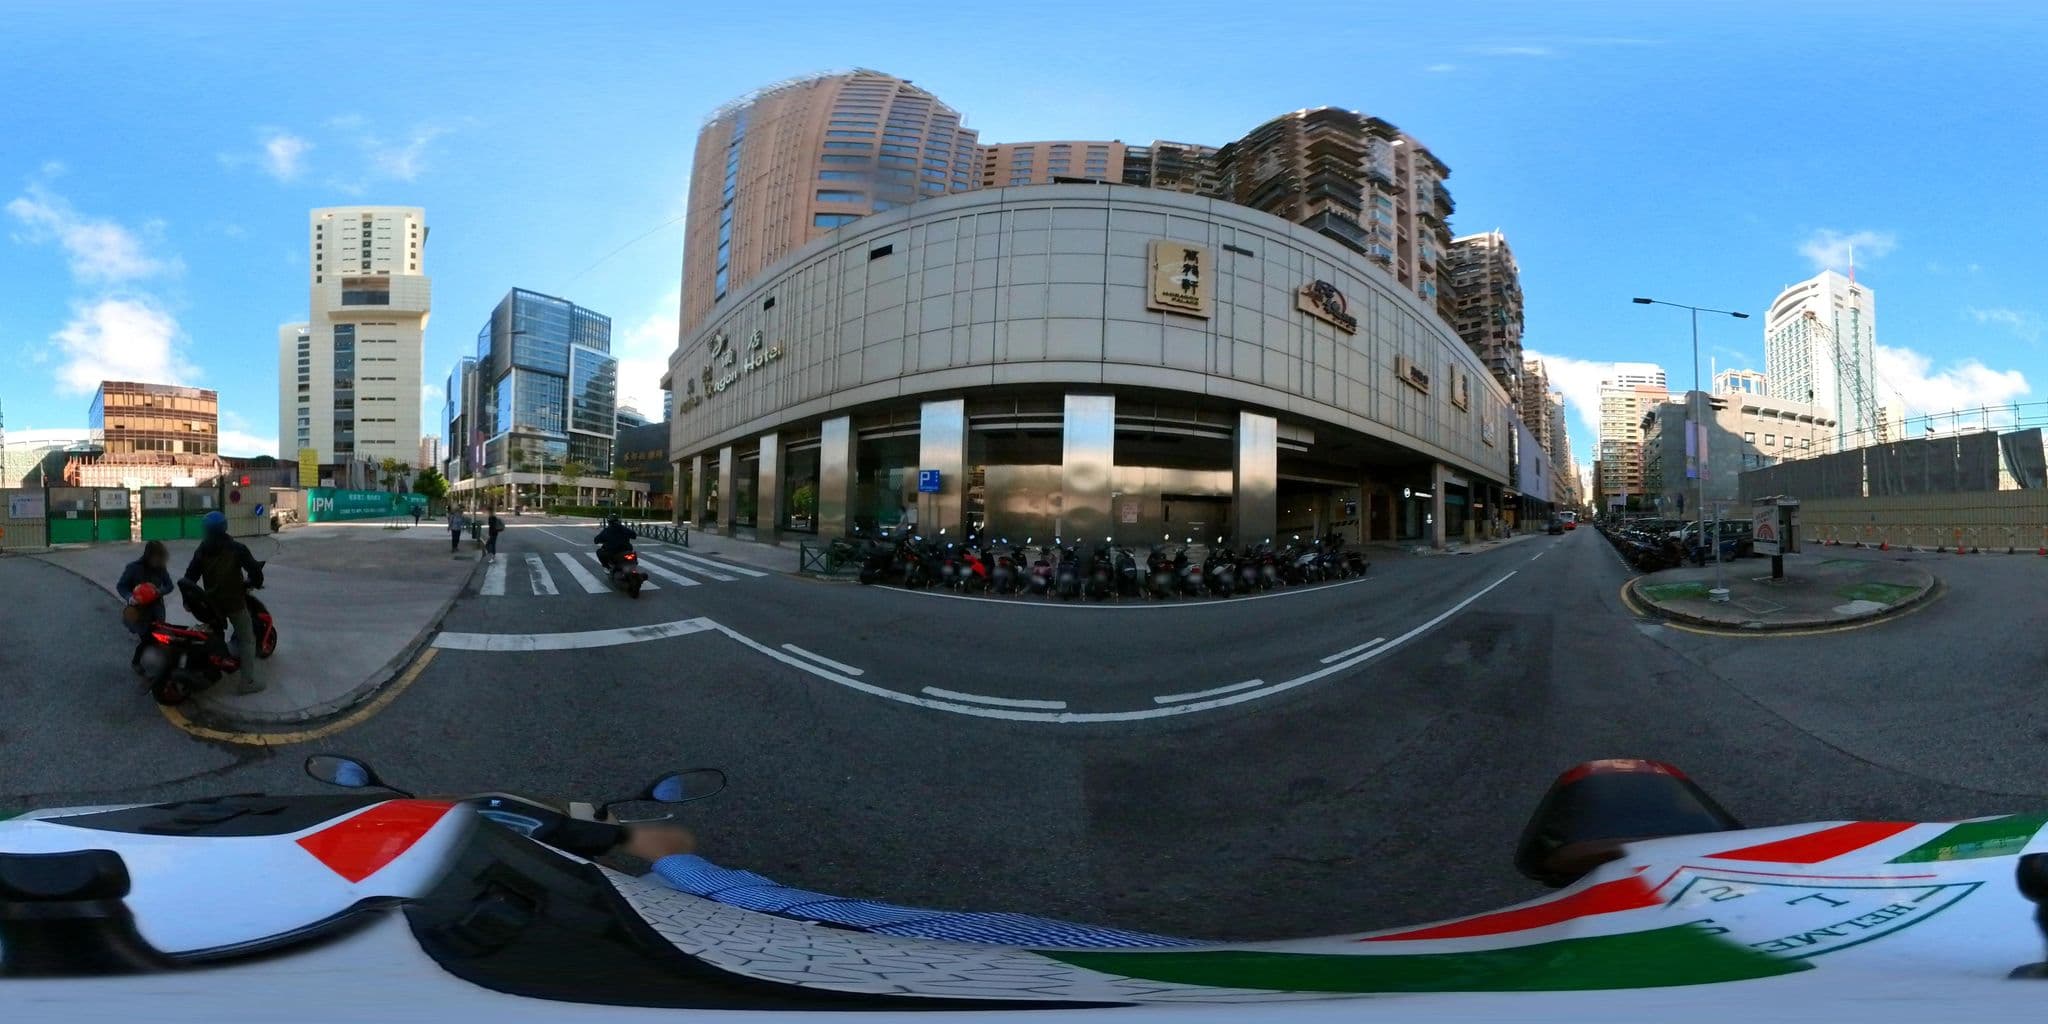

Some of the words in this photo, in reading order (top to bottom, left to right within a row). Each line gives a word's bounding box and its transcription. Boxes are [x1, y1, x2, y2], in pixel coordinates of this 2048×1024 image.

[744, 339, 785, 373] Hotel
[920, 471, 930, 487] P
[312, 497, 334, 513] IPM
[1749, 903, 1917, 954] HELME
